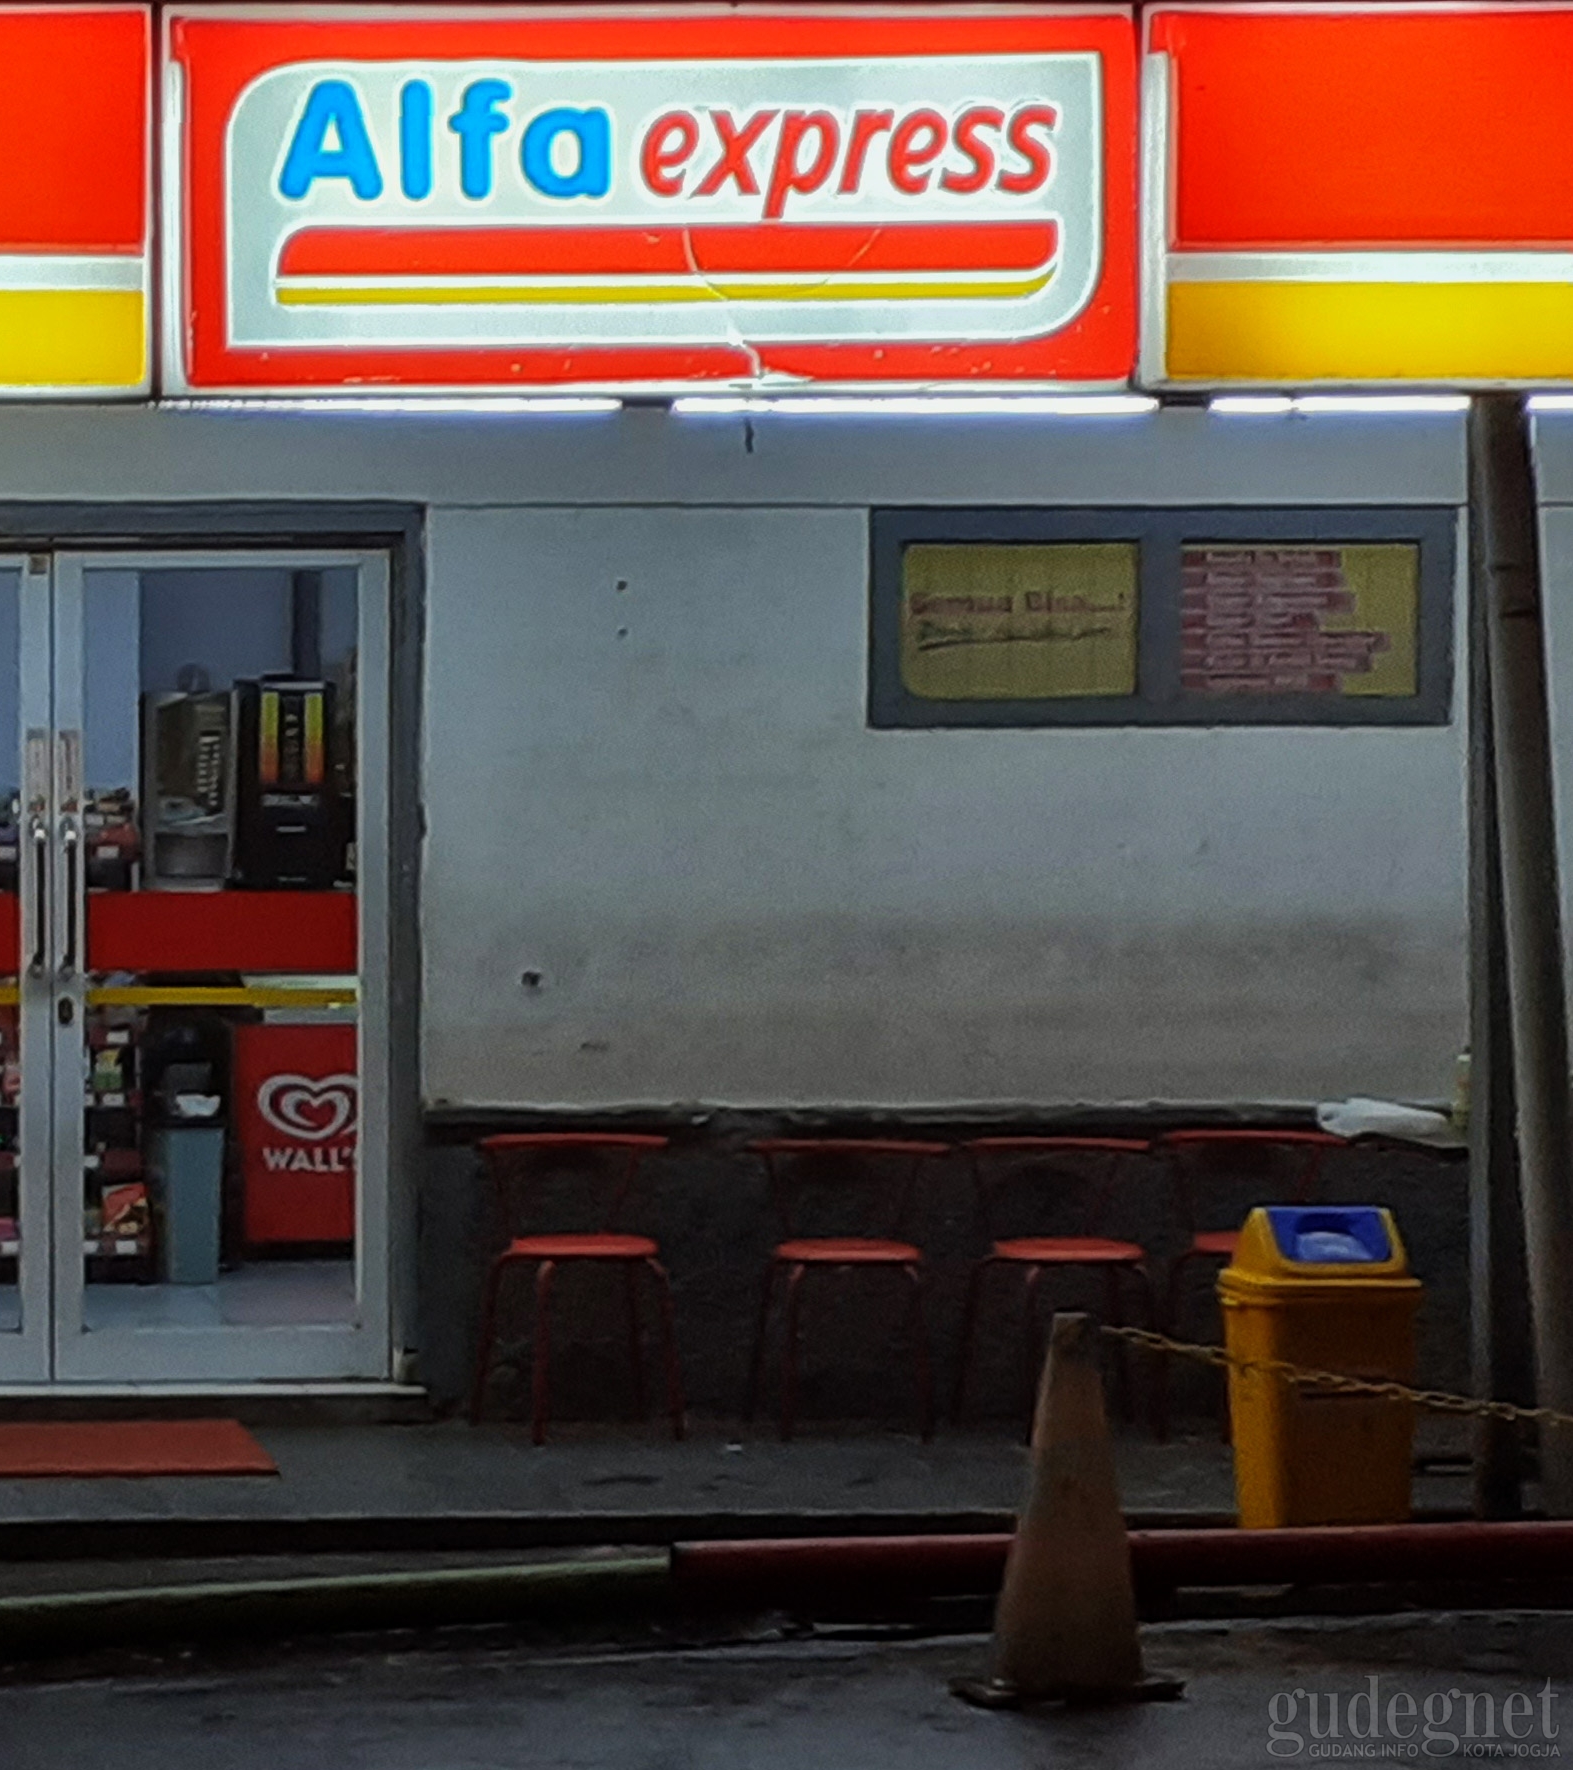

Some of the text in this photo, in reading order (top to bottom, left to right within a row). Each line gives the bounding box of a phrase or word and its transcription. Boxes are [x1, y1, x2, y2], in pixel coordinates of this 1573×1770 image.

[276, 78, 1061, 221] Alfa express
[262, 1146, 356, 1173] WALL'
